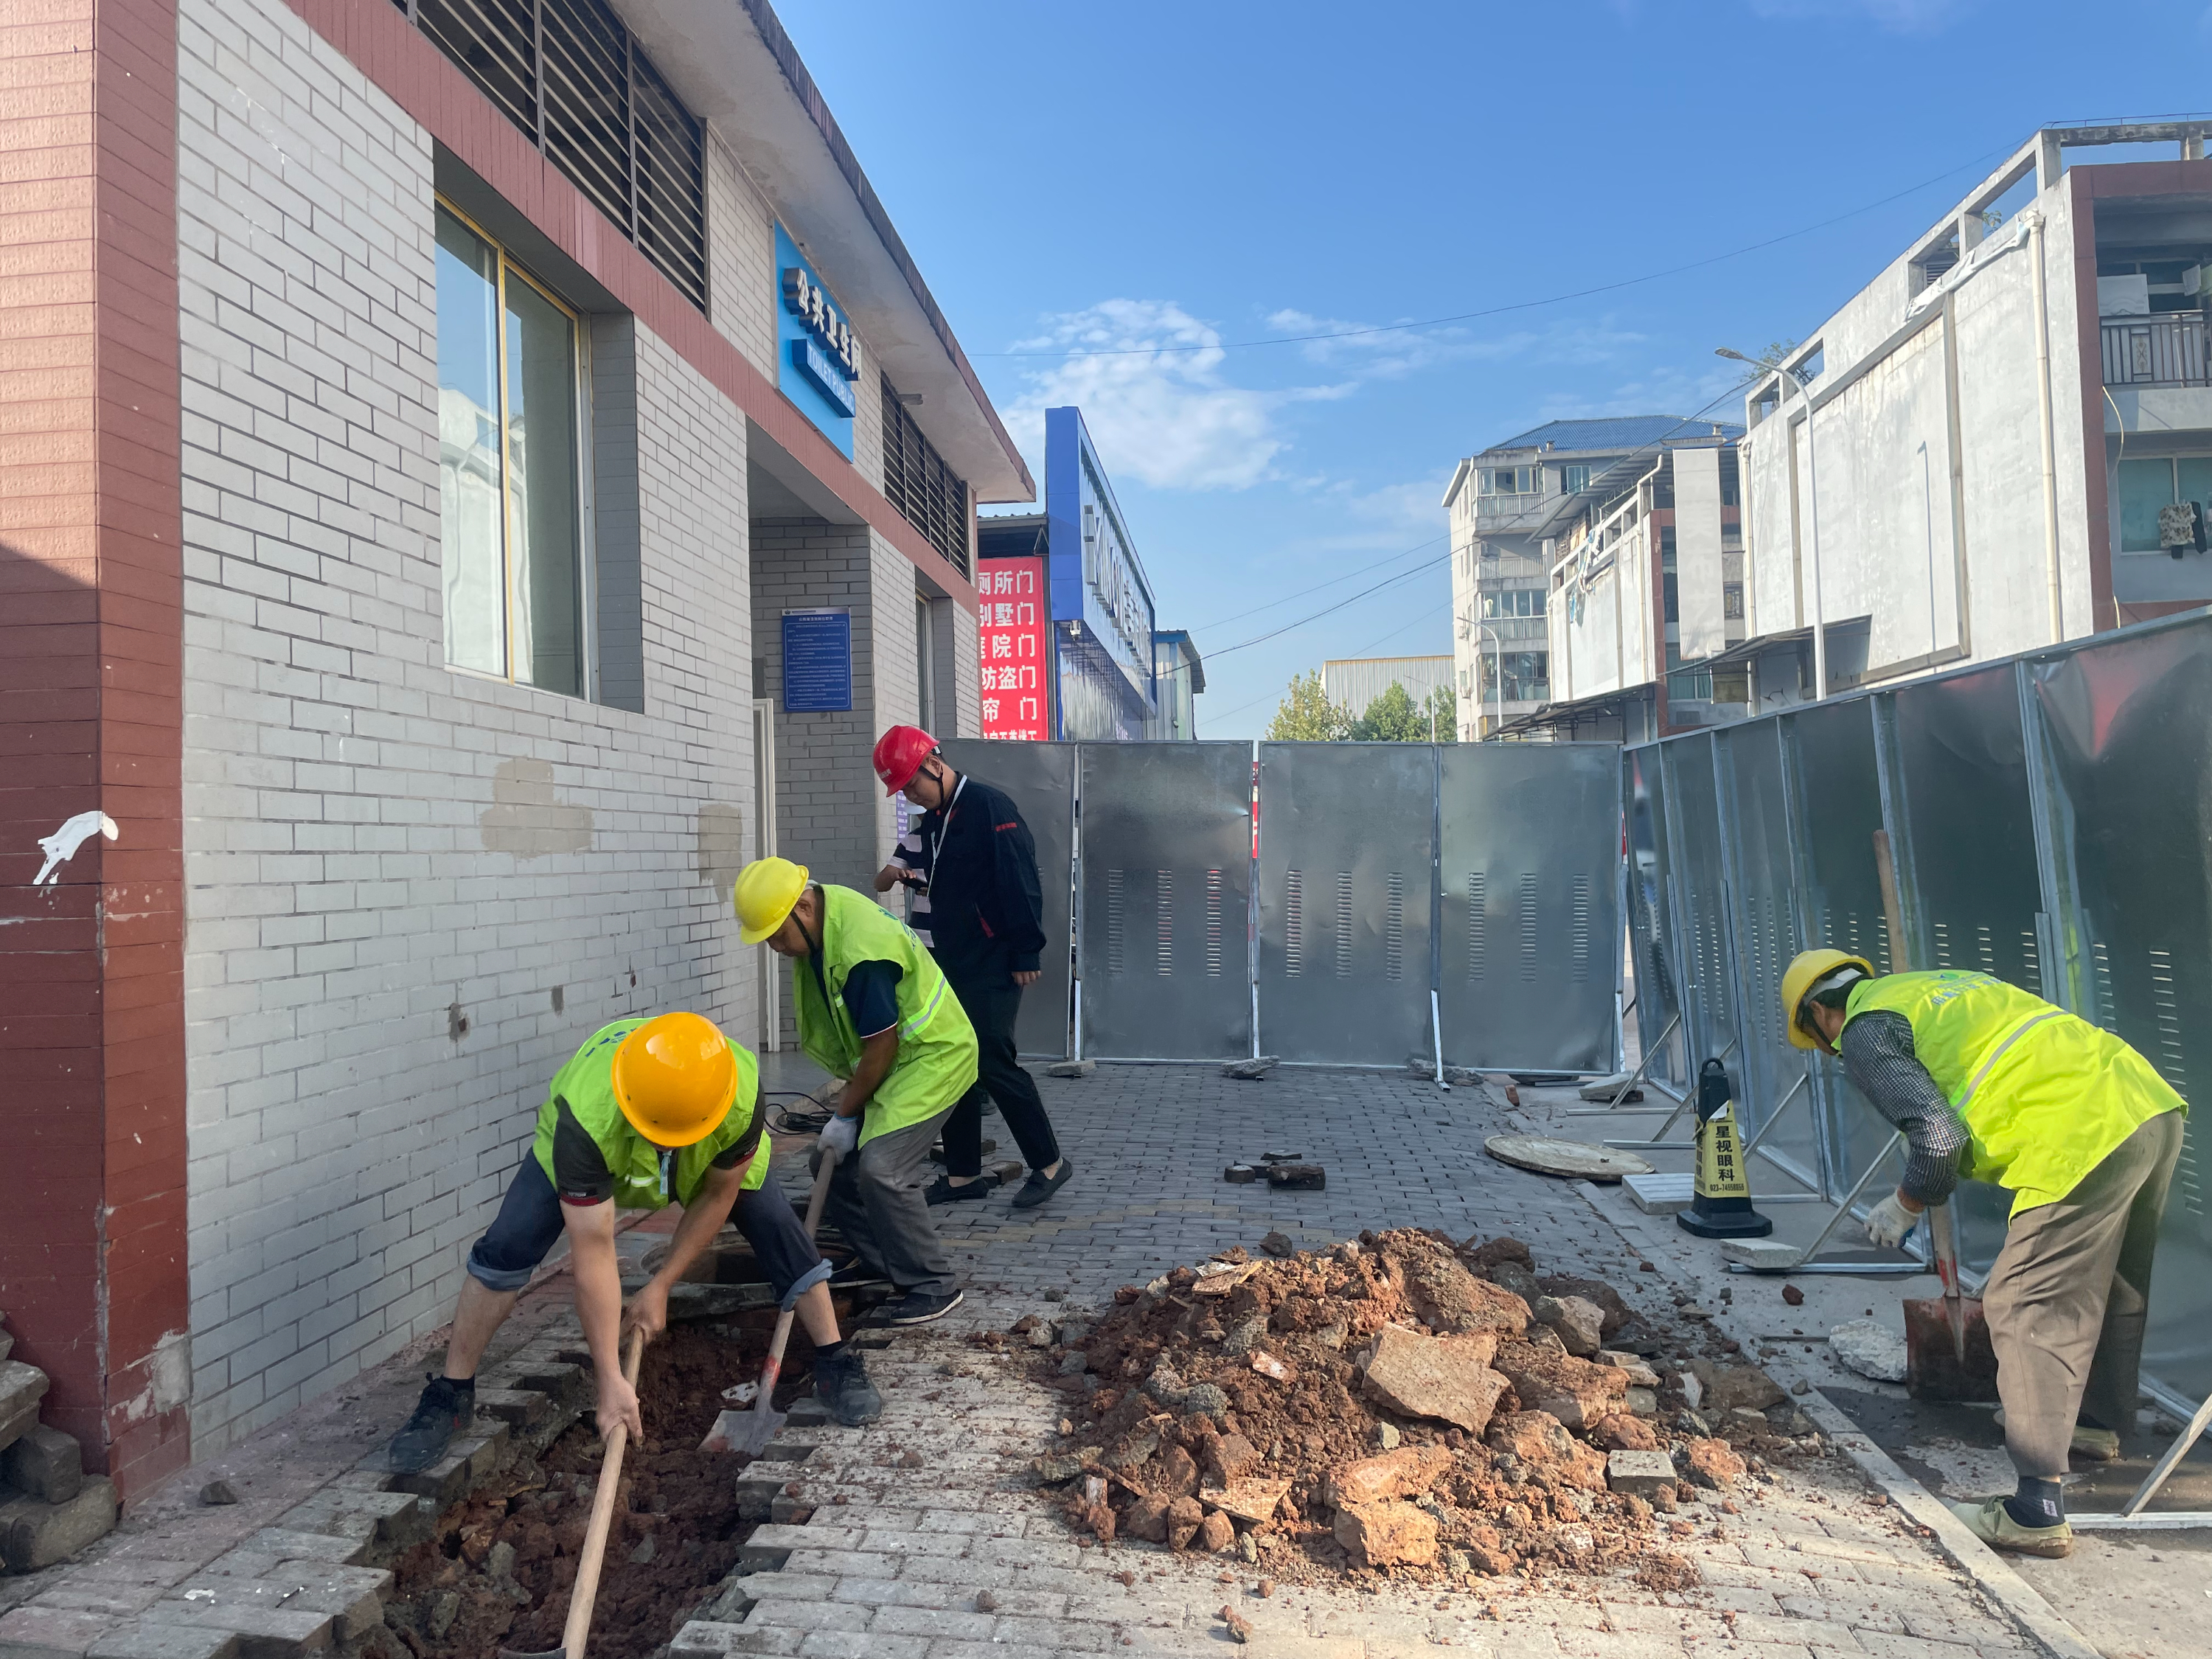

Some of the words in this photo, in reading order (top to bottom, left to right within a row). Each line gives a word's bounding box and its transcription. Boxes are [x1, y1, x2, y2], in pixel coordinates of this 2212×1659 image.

[797, 268, 861, 381] 公共卫生间
[807, 345, 831, 386] TOILET
[832, 373, 855, 412] PUBLIC
[981, 665, 1036, 690] 防盗门
[1716, 1126, 1735, 1181] 星视眼科
